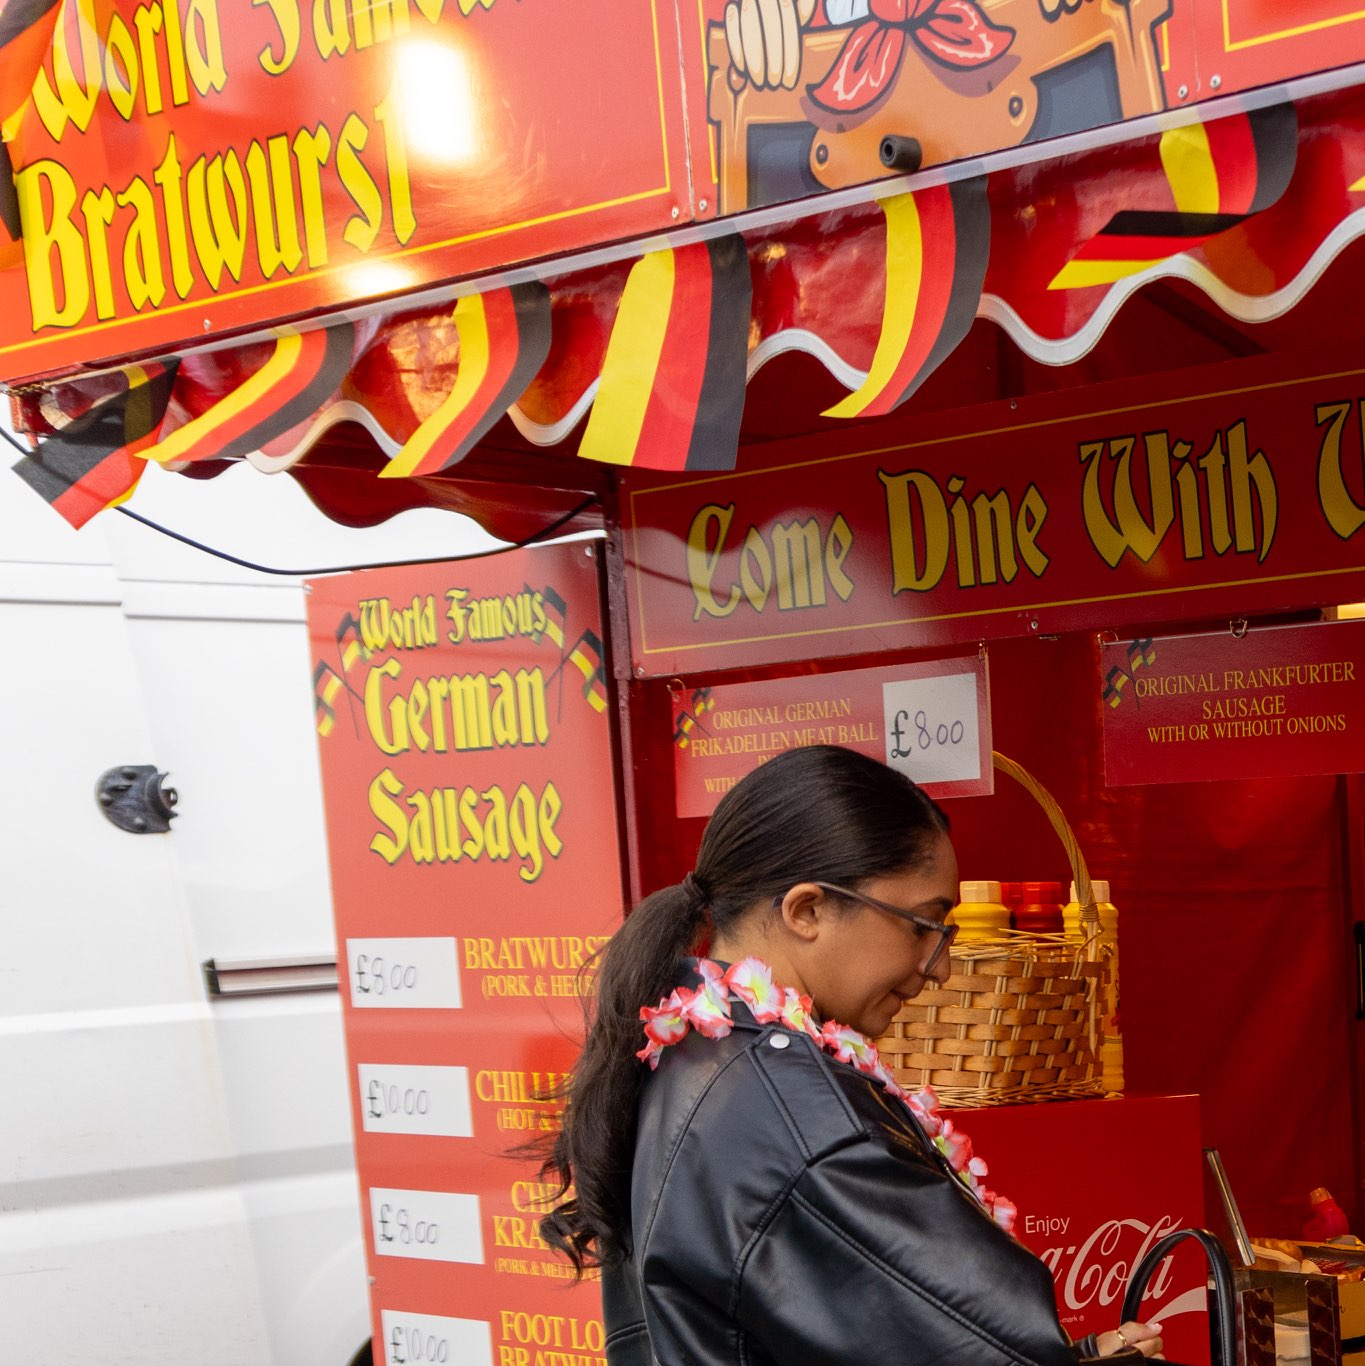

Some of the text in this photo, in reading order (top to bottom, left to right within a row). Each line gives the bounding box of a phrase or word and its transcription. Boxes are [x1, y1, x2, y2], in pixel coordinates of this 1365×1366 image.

[15, 92, 418, 333] Bratwurst
[685, 502, 855, 621] Come
[878, 466, 1049, 596] Dine
[1079, 419, 1279, 569] With
[358, 587, 547, 651] World Famous
[1134, 661, 1356, 698] ORIGINAL FRANKFURTER
[364, 656, 550, 756] German
[712, 698, 852, 730] ORIGINAL GERMAN
[1201, 695, 1287, 720] SAUSAGE
[690, 722, 879, 757] FRIKADELLEN MEAT BALL
[890, 710, 964, 758] £8.00
[1147, 714, 1347, 744] WITH OR WITHOUT ONIONS
[367, 767, 564, 883] Sausage
[481, 975, 597, 1000] (PORK & HERB
[475, 1070, 558, 1104] CHILLI
[496, 1108, 536, 1133] (HOT
[1025, 1215, 1070, 1236] Enjoy
[1039, 1215, 1185, 1310] a-Cola
[500, 1310, 565, 1347] FOOT
